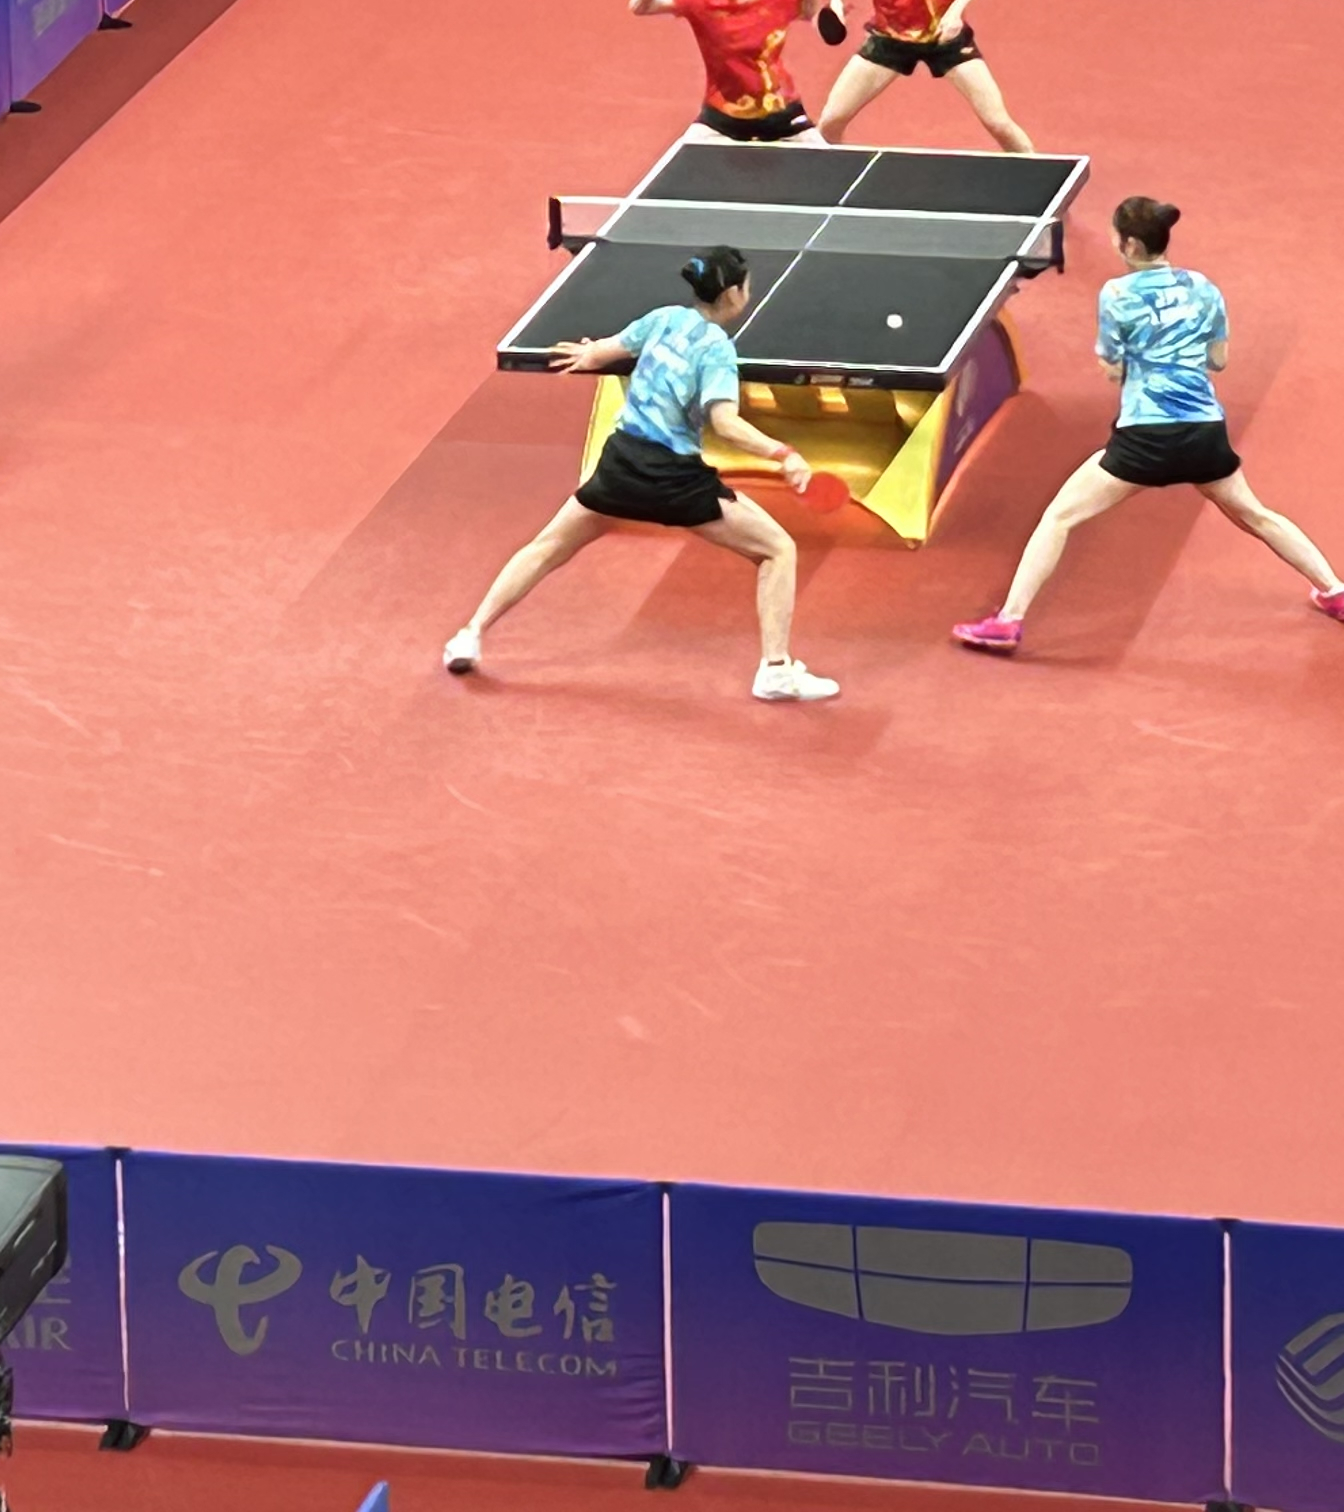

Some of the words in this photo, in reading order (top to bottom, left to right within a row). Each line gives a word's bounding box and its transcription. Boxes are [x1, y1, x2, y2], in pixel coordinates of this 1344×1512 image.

[329, 1254, 617, 1342] 中国电信
[331, 1340, 441, 1367] CHINA
[452, 1347, 617, 1376] TELECOM
[788, 1357, 1099, 1431] 吉利汽车
[788, 1421, 952, 1451] GEELY
[962, 1433, 1101, 1466] AUTO
